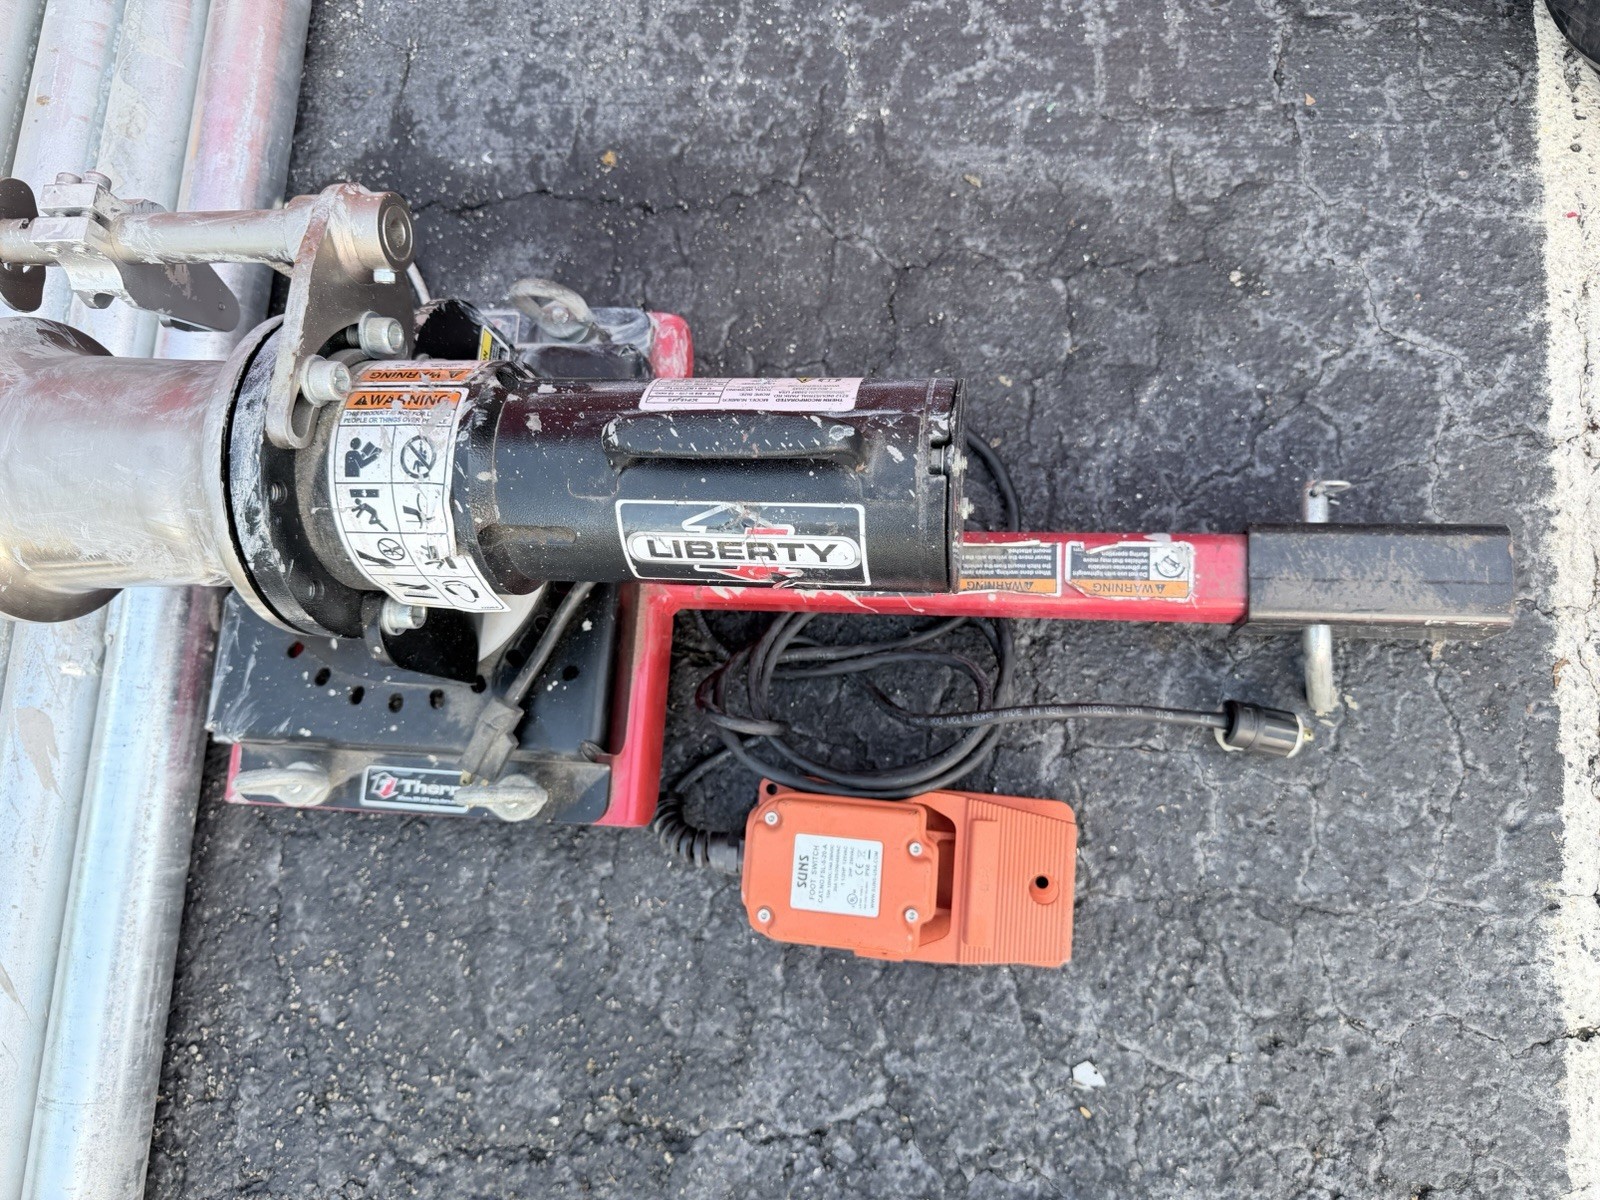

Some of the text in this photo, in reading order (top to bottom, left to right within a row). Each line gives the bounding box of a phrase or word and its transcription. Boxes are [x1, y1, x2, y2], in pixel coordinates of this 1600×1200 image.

[646, 539, 838, 562] LIBERTY
[967, 580, 1024, 590] WARNING
[1093, 583, 1154, 592] WARNING
[1029, 707, 1040, 715] IN
[1044, 706, 1063, 715] USA
[811, 845, 819, 875] SWITCH
[797, 855, 809, 888] SUNS
